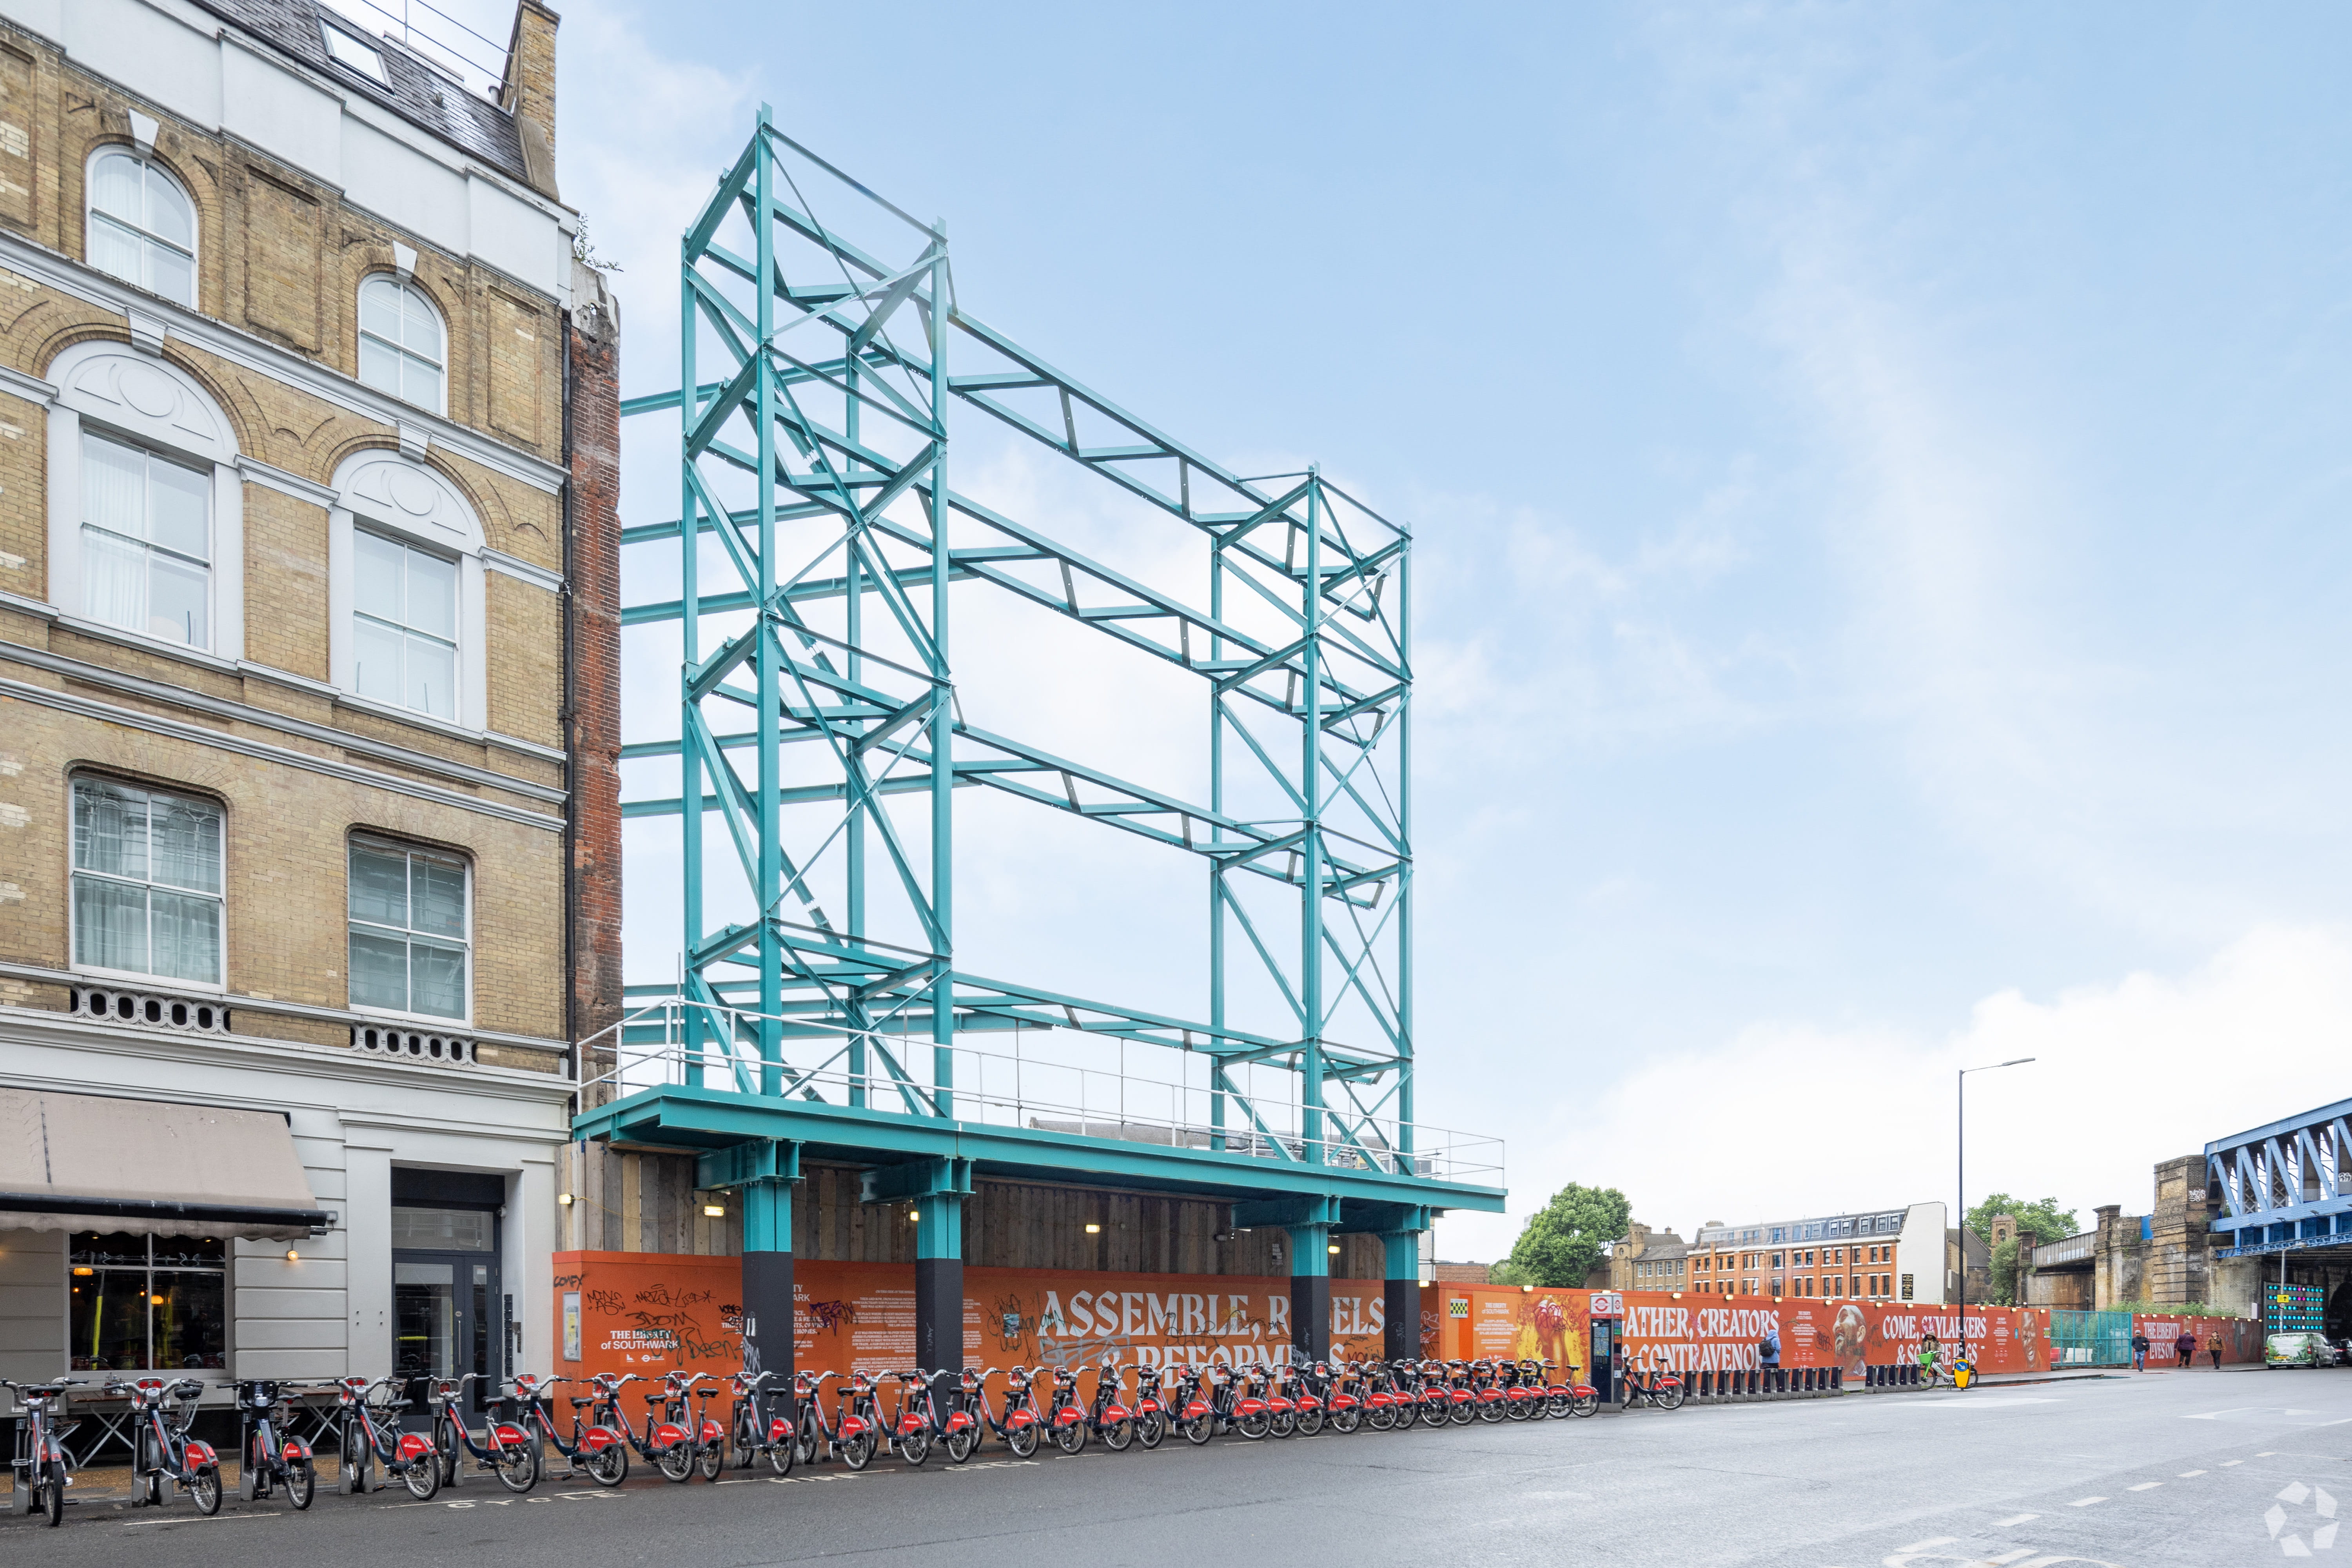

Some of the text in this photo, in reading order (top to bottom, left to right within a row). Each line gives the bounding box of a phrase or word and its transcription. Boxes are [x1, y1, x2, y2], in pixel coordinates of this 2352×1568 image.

[1037, 1290, 1261, 1342] ASSEMBLE,
[1697, 1308, 1779, 1338] CREATORS
[610, 1330, 671, 1339] THE LIBERTY
[1883, 1315, 1920, 1343] COME,
[2144, 1322, 2156, 1339] THE
[2157, 1322, 2180, 1339] LIBERTY
[601, 1340, 680, 1350] of SOUTHWARK
[2150, 1342, 2174, 1359] LIVES ON
[1897, 1344, 1906, 1365] &
[1953, 1342, 1978, 1366] PGS
[447, 1492, 627, 1508] CYCLE
